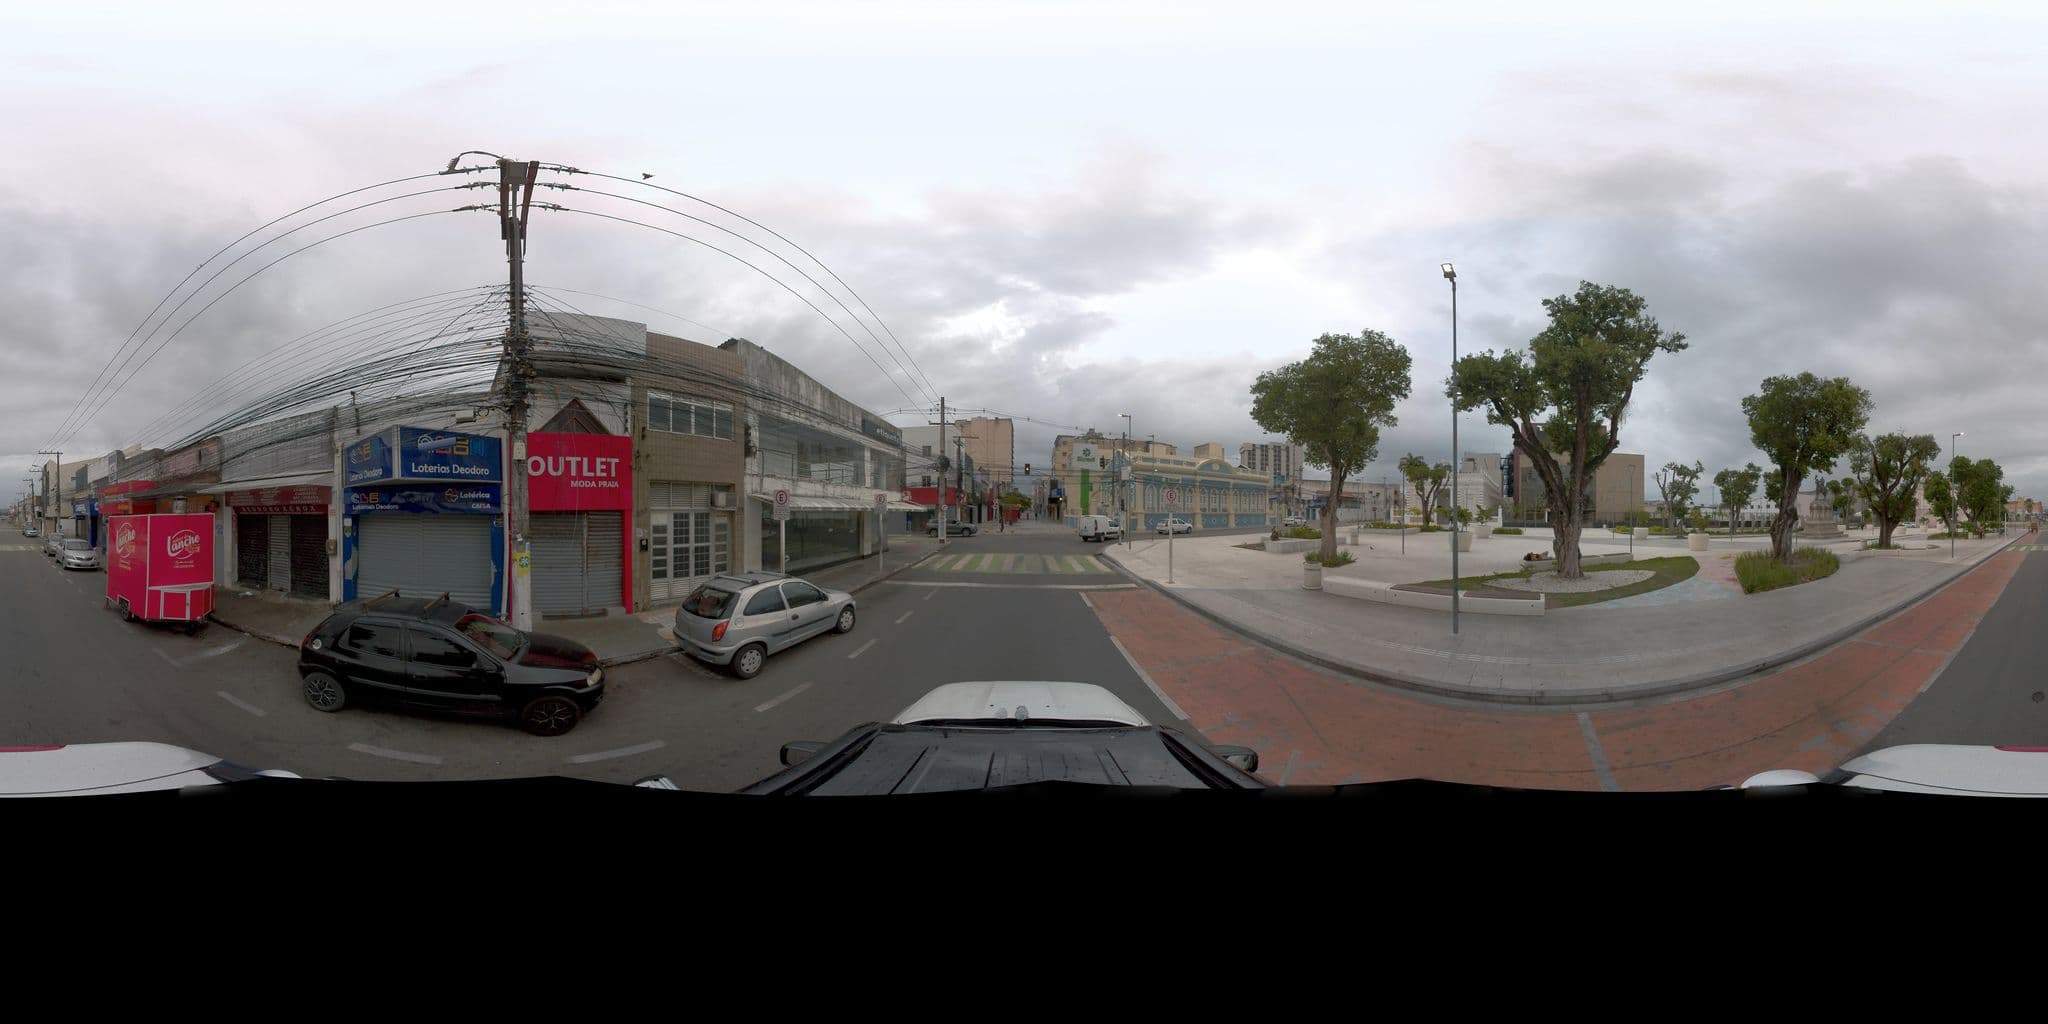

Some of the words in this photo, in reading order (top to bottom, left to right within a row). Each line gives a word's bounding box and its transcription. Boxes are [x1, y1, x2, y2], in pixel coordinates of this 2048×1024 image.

[412, 462, 450, 475] Loterias
[452, 464, 490, 478] Deodoro
[527, 456, 620, 477] OUTLET
[571, 480, 597, 488] MODA
[598, 481, 619, 489] PRAIA
[460, 491, 491, 499] Lotérica
[168, 534, 200, 557] Lanche
